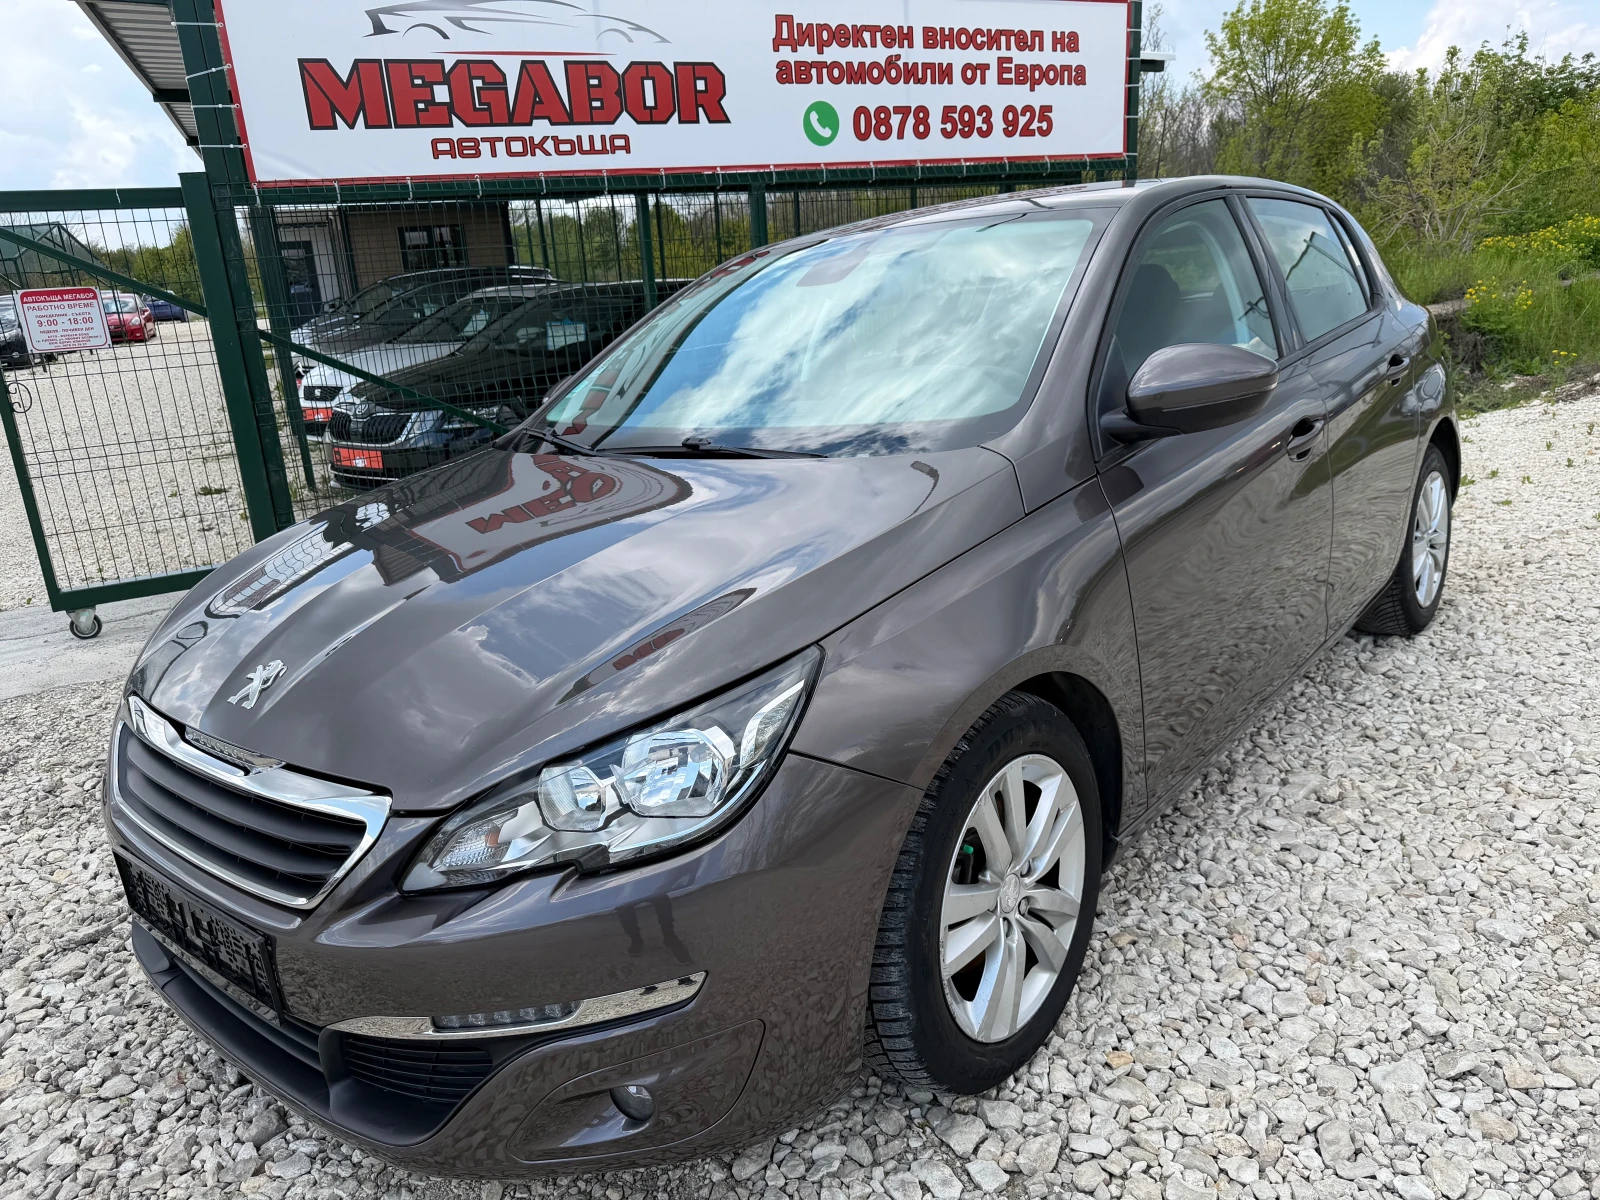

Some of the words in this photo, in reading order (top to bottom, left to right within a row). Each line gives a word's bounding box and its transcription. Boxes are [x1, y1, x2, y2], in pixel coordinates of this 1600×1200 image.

[772, 14, 914, 55] Директен
[922, 26, 1044, 53] вносител
[1052, 29, 1080, 53] на
[775, 54, 953, 85] автомобили
[961, 63, 990, 85] от
[997, 57, 1086, 92] Европа
[297, 58, 731, 131] MEGABOR
[853, 105, 931, 141] 0878
[940, 105, 993, 140] 593
[1002, 105, 1053, 138] 925
[430, 134, 631, 160] АВТОКЪЩА
[23, 294, 62, 302] АВТОКЪЩА
[63, 292, 94, 300] МЕГАБОР
[27, 303, 66, 312] РАБОТНО
[67, 302, 95, 310] ВРЕМЕ
[36, 318, 58, 327] 9:00
[67, 316, 94, 325] 18:00
